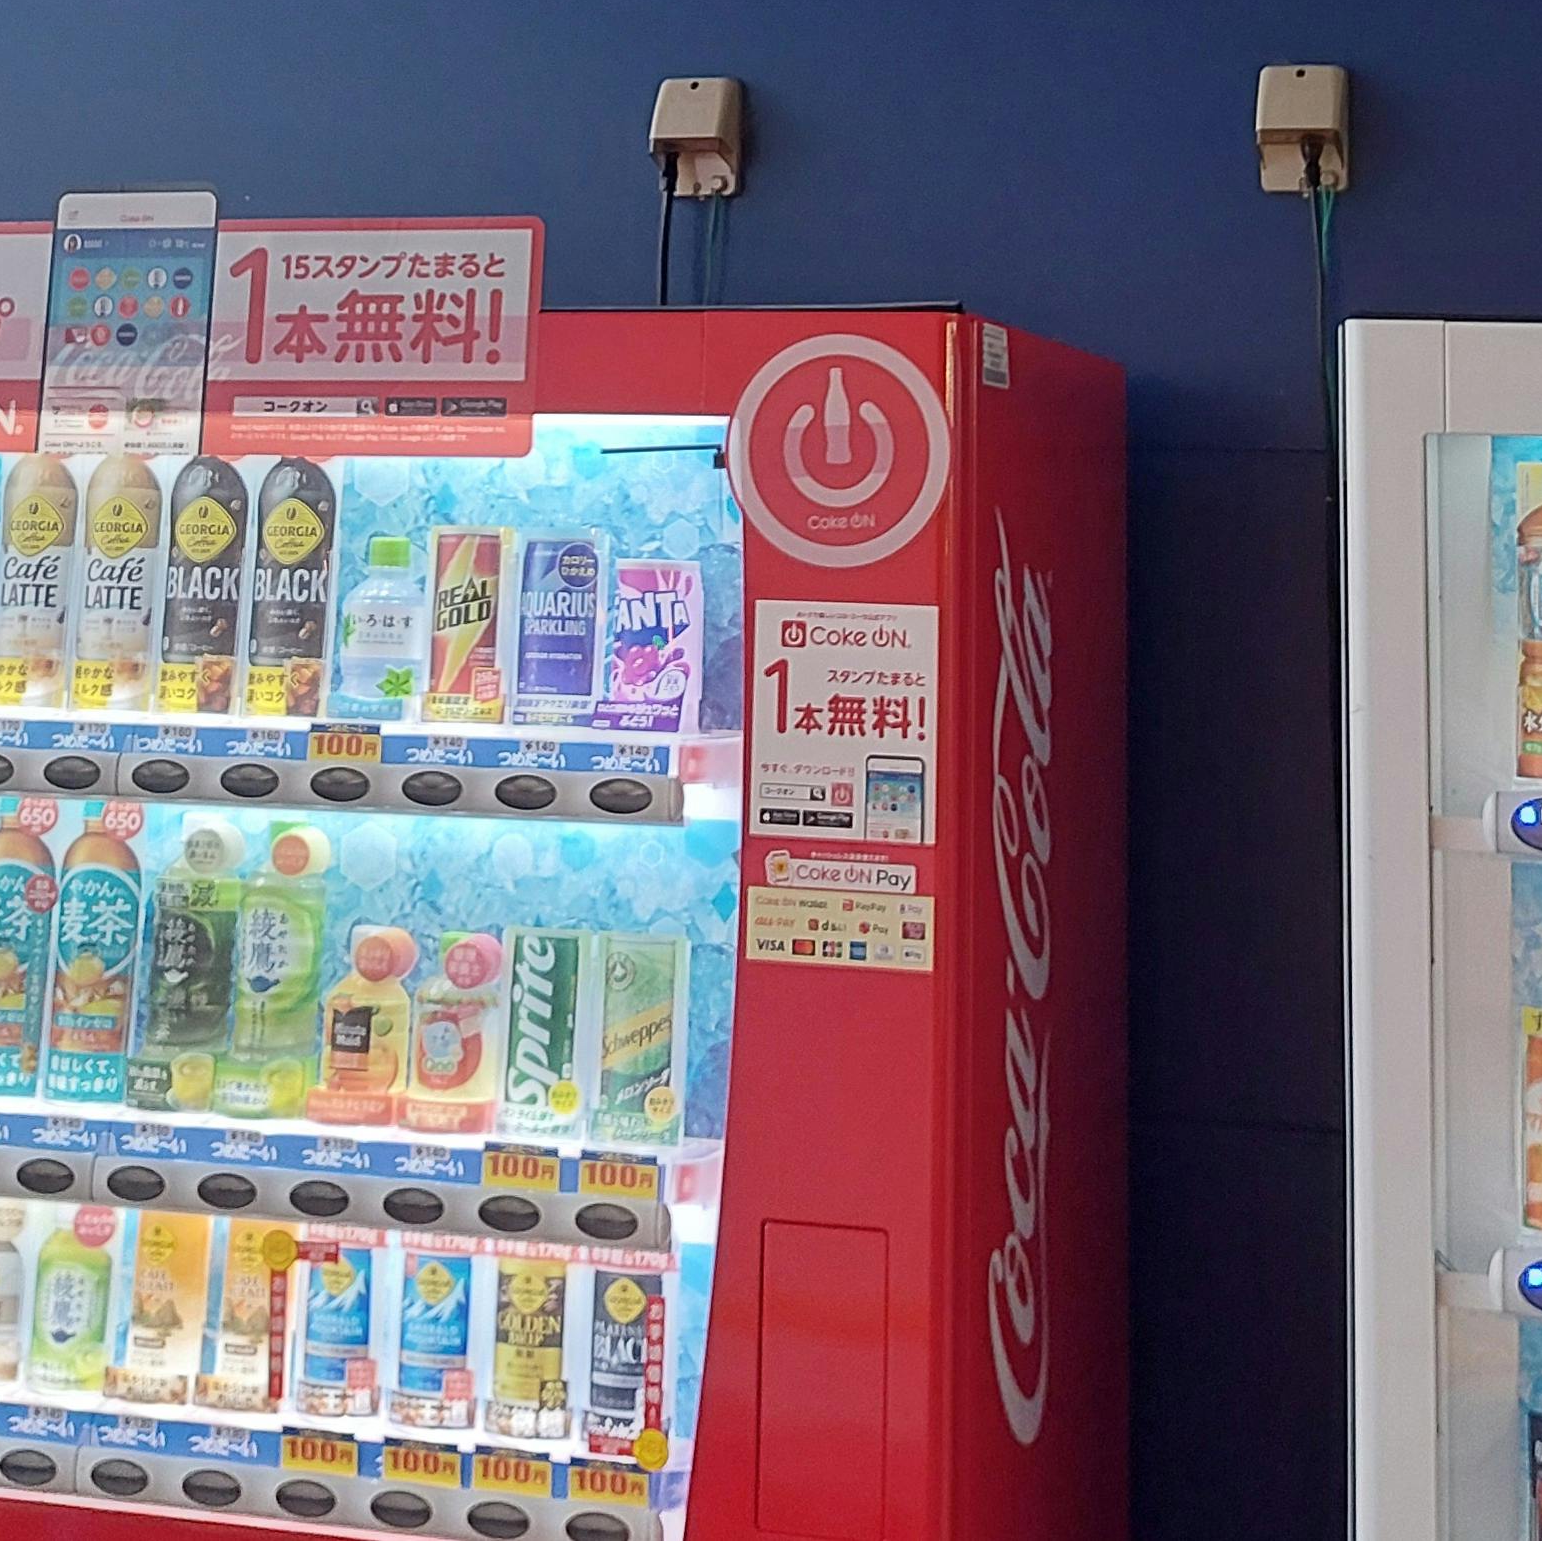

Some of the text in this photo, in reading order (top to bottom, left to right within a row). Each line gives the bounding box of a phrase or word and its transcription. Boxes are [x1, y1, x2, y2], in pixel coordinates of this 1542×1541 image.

[282, 251, 505, 280] 15スタンプたまると
[263, 400, 328, 413] コークオン
[10, 520, 60, 533] GEORGIA
[94, 521, 144, 534] GEORGIA
[179, 523, 230, 537] GEORGIA
[267, 525, 318, 538] GEORGIA
[808, 515, 848, 530] Coke
[4, 556, 61, 583] Café
[88, 558, 145, 584] Café
[1, 583, 58, 608] LATTE
[167, 566, 240, 601] BLACK
[255, 568, 327, 603] BLACK
[438, 577, 492, 606] REAL
[85, 585, 142, 610] LATTE
[436, 603, 491, 631] GOLD
[615, 591, 690, 631] ANTA
[810, 626, 867, 647] Coke
[827, 669, 926, 687] スタンプたまると
[314, 734, 377, 756] 100円
[20, 810, 55, 827] 650
[105, 811, 140, 829] 650
[796, 864, 840, 881] Coke
[876, 870, 911, 891] Pay
[61, 899, 133, 944] 麦茶
[757, 939, 785, 951] VISA
[508, 934, 555, 1109] Sprite
[490, 1153, 555, 1179] 100円
[586, 1162, 653, 1187] 100円
[288, 1438, 354, 1465] 100円
[390, 1448, 457, 1476] 100円
[480, 1455, 547, 1484] 100円
[577, 1469, 644, 1496] 100円
